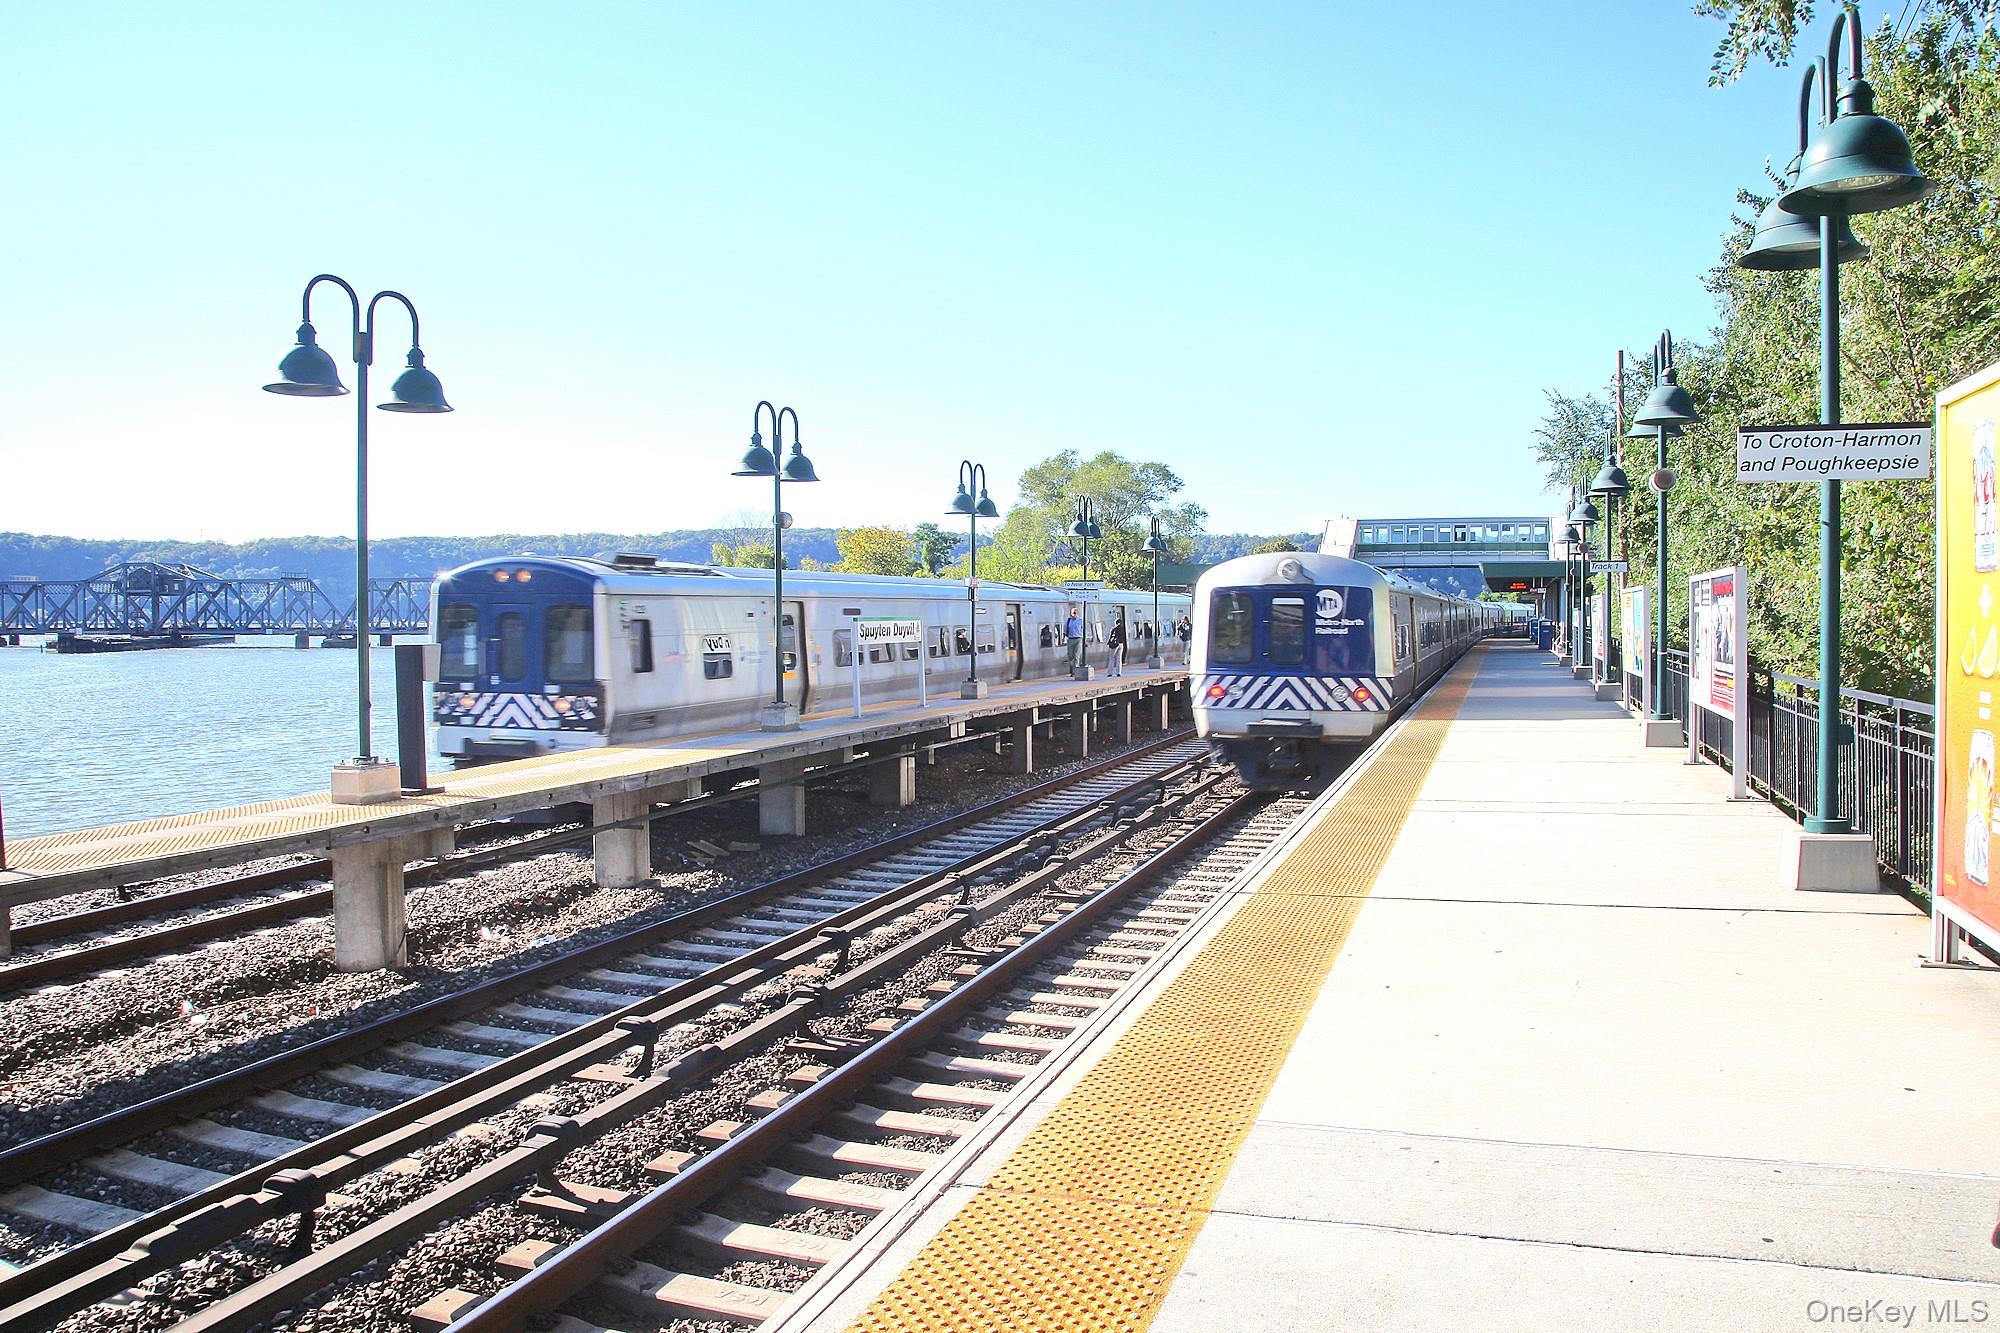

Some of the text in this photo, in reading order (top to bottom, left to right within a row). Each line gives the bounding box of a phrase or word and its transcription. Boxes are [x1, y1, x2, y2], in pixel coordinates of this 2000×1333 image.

[1742, 432, 1921, 449] To Croton-Harmon
[1740, 454, 1919, 474] and Poughkeepsie
[1315, 595, 1338, 612] MTA
[1315, 618, 1364, 626] Metro-North
[859, 622, 915, 640] Spuyten Duyvil
[1315, 627, 1348, 635] Railroad
